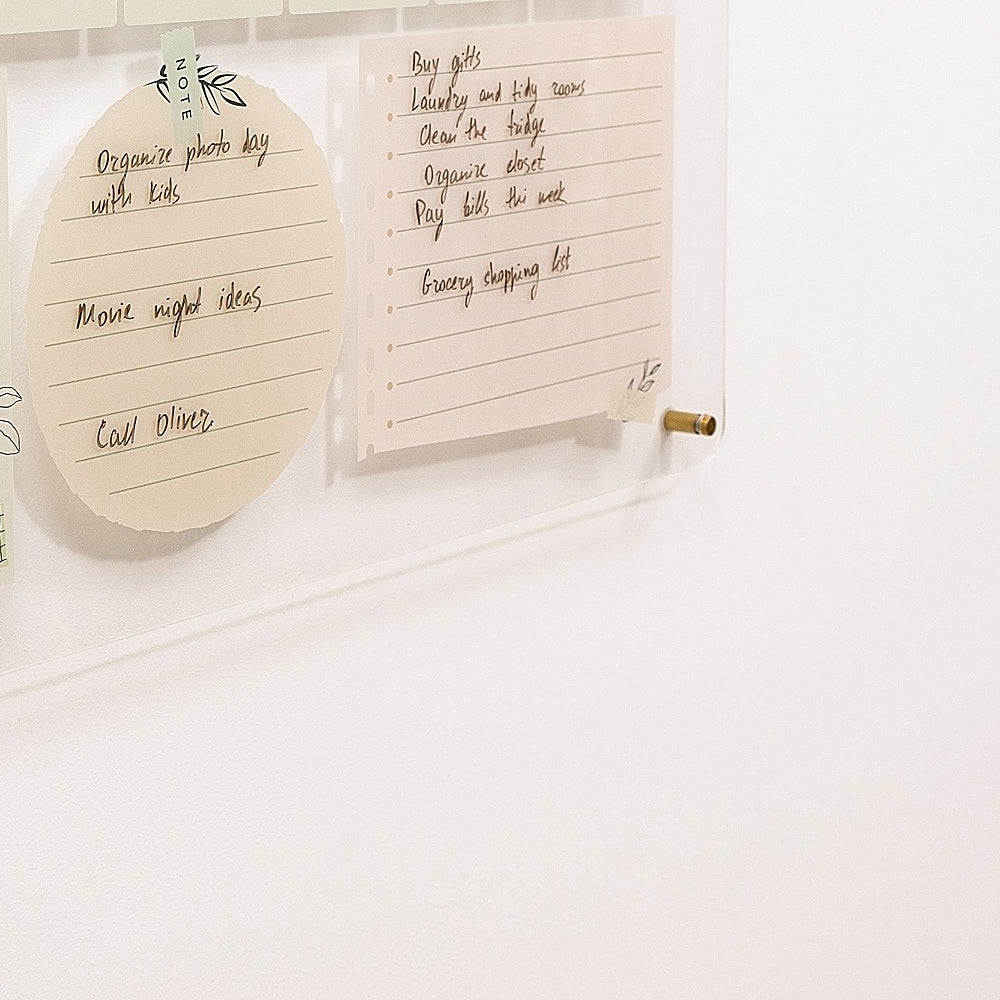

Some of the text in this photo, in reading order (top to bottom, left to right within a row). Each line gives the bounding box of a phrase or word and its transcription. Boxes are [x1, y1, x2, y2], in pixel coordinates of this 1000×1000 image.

[175, 58, 192, 121] NOTE
[412, 45, 481, 94] Buy gifts
[411, 87, 468, 128] Laundry
[480, 82, 502, 102] and
[512, 77, 538, 113] tidy
[420, 124, 457, 146] Clean
[97, 129, 271, 196] Organize photo day
[425, 146, 546, 204] Organize closet
[90, 183, 132, 216] with
[416, 199, 444, 242] Pay
[464, 191, 489, 217] bills
[422, 245, 572, 308] Grocery shopping list
[75, 283, 263, 338] Movie night ideas
[96, 417, 137, 449] Call
